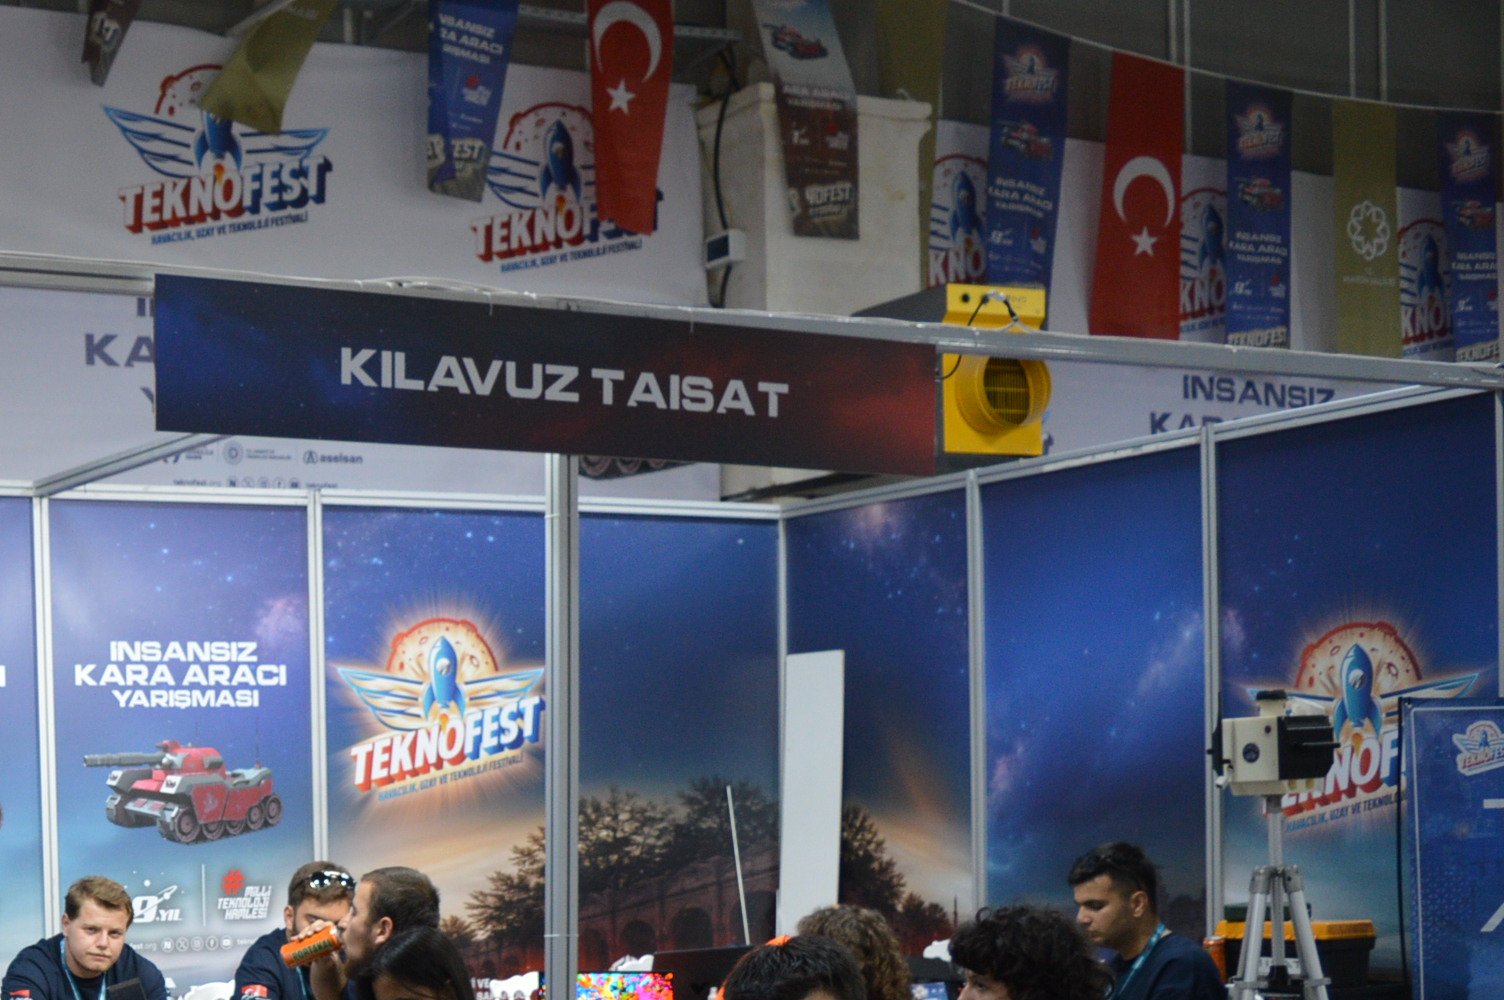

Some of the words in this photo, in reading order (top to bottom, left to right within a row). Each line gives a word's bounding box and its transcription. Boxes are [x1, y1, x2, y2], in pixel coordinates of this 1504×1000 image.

[118, 155, 333, 235] TEKNOFEST
[340, 346, 581, 404] KILAVUZ
[590, 367, 790, 419] TAISAT
[74, 664, 176, 687] KARA
[181, 664, 287, 687] ARACI
[111, 690, 260, 709] YARIŞMASI
[351, 696, 546, 793] TEKNOFEST
